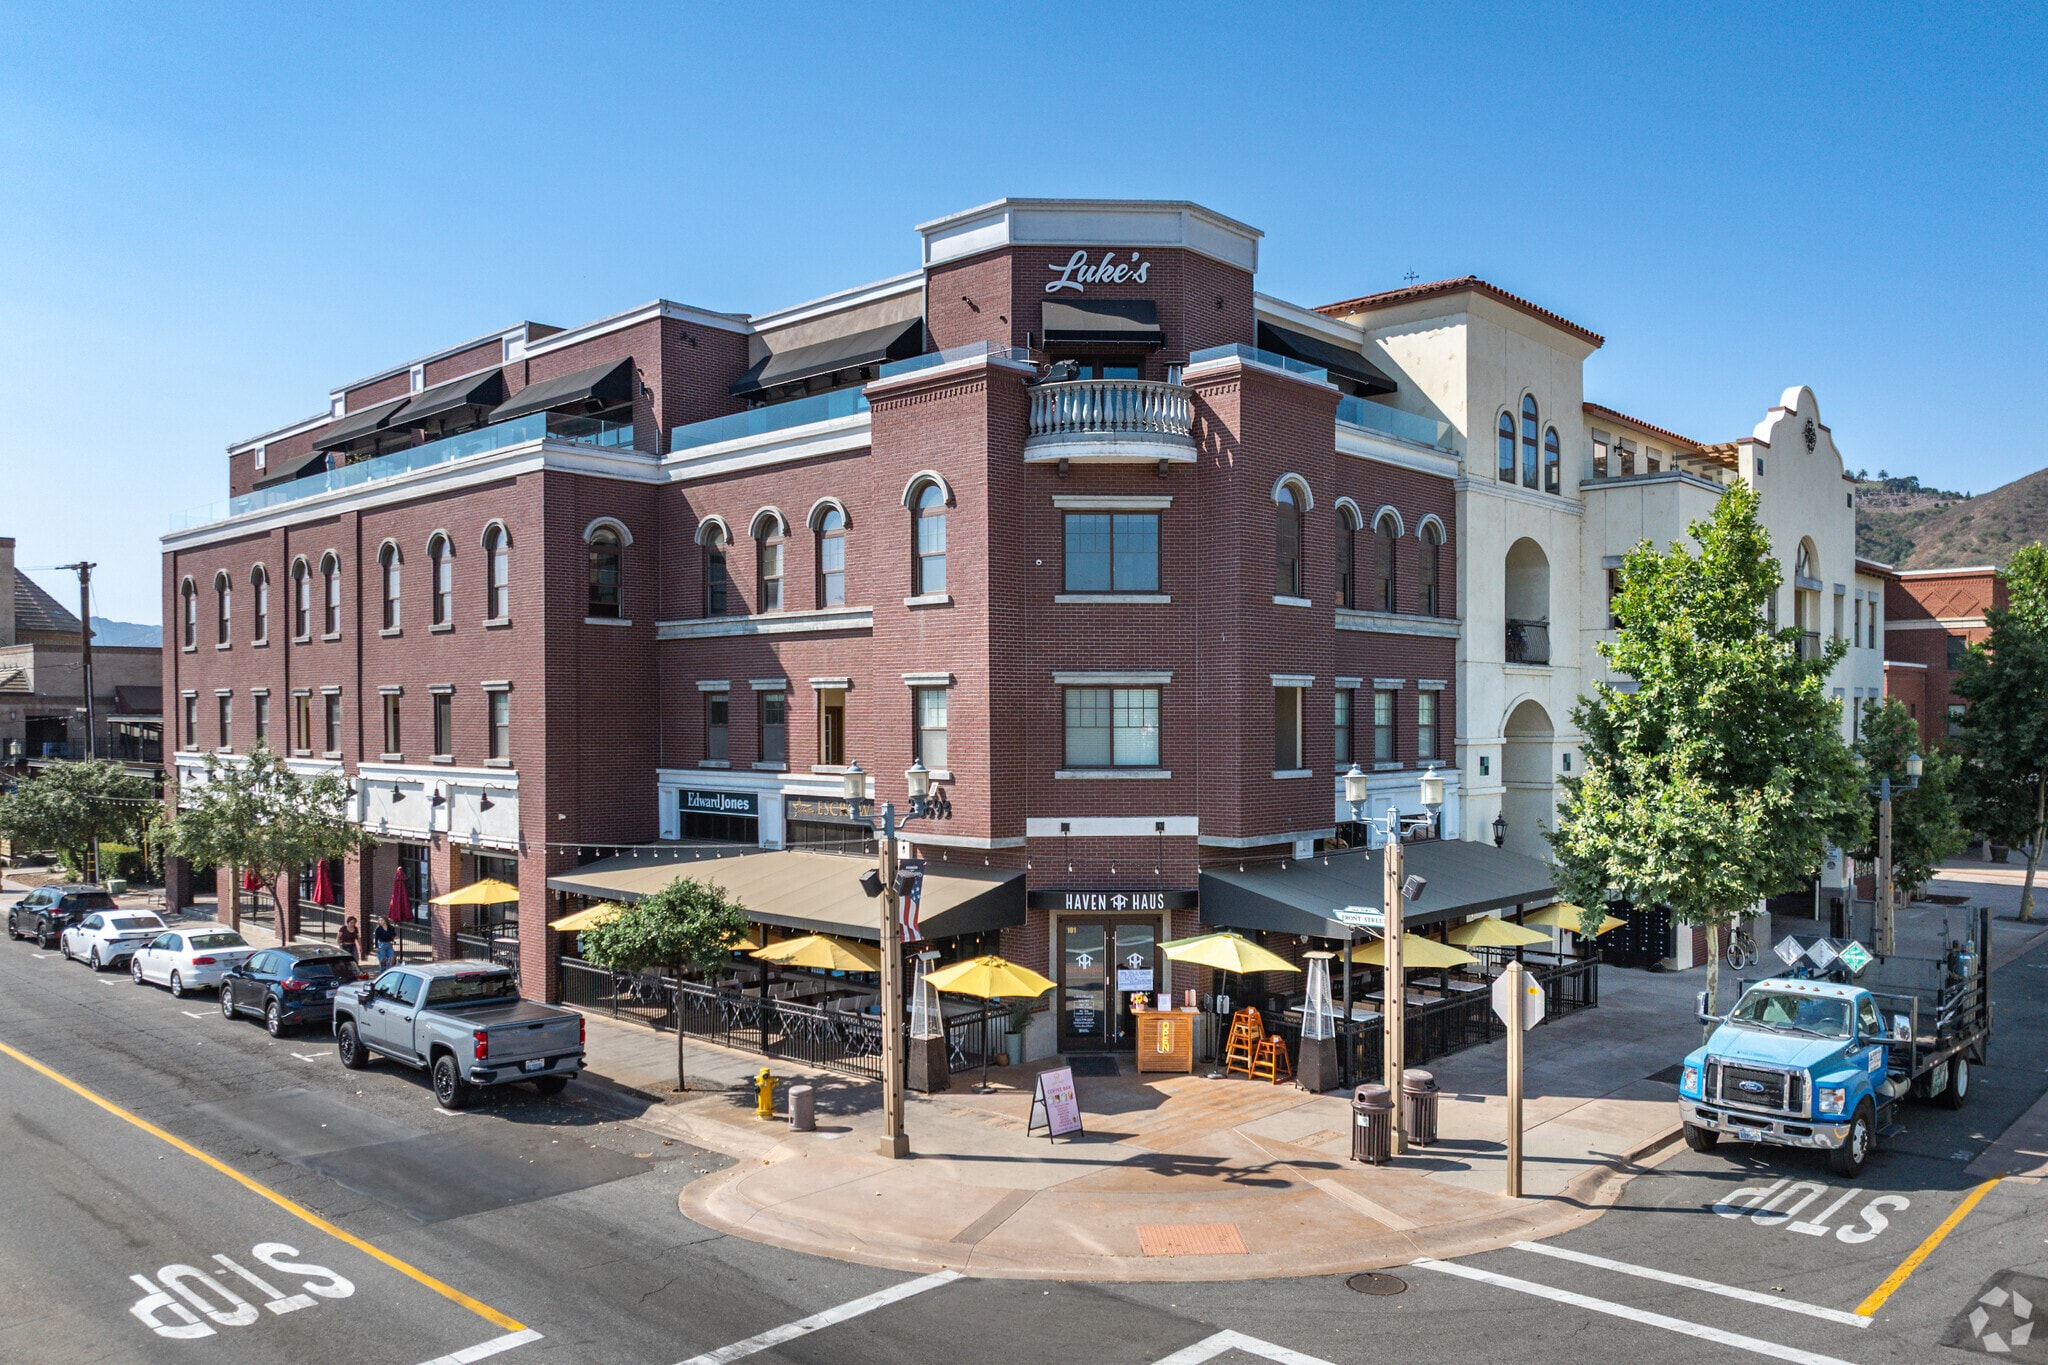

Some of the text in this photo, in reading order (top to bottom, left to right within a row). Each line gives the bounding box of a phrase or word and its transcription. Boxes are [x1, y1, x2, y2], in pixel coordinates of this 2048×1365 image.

[1045, 250, 1151, 293] Luke's
[1065, 893, 1164, 911] HAVEN HAUS
[1341, 914, 1361, 922] FRONT
[1162, 1021, 1170, 1053] OPEN
[1711, 1177, 1910, 1244] STOP
[129, 1242, 355, 1339] STOP
